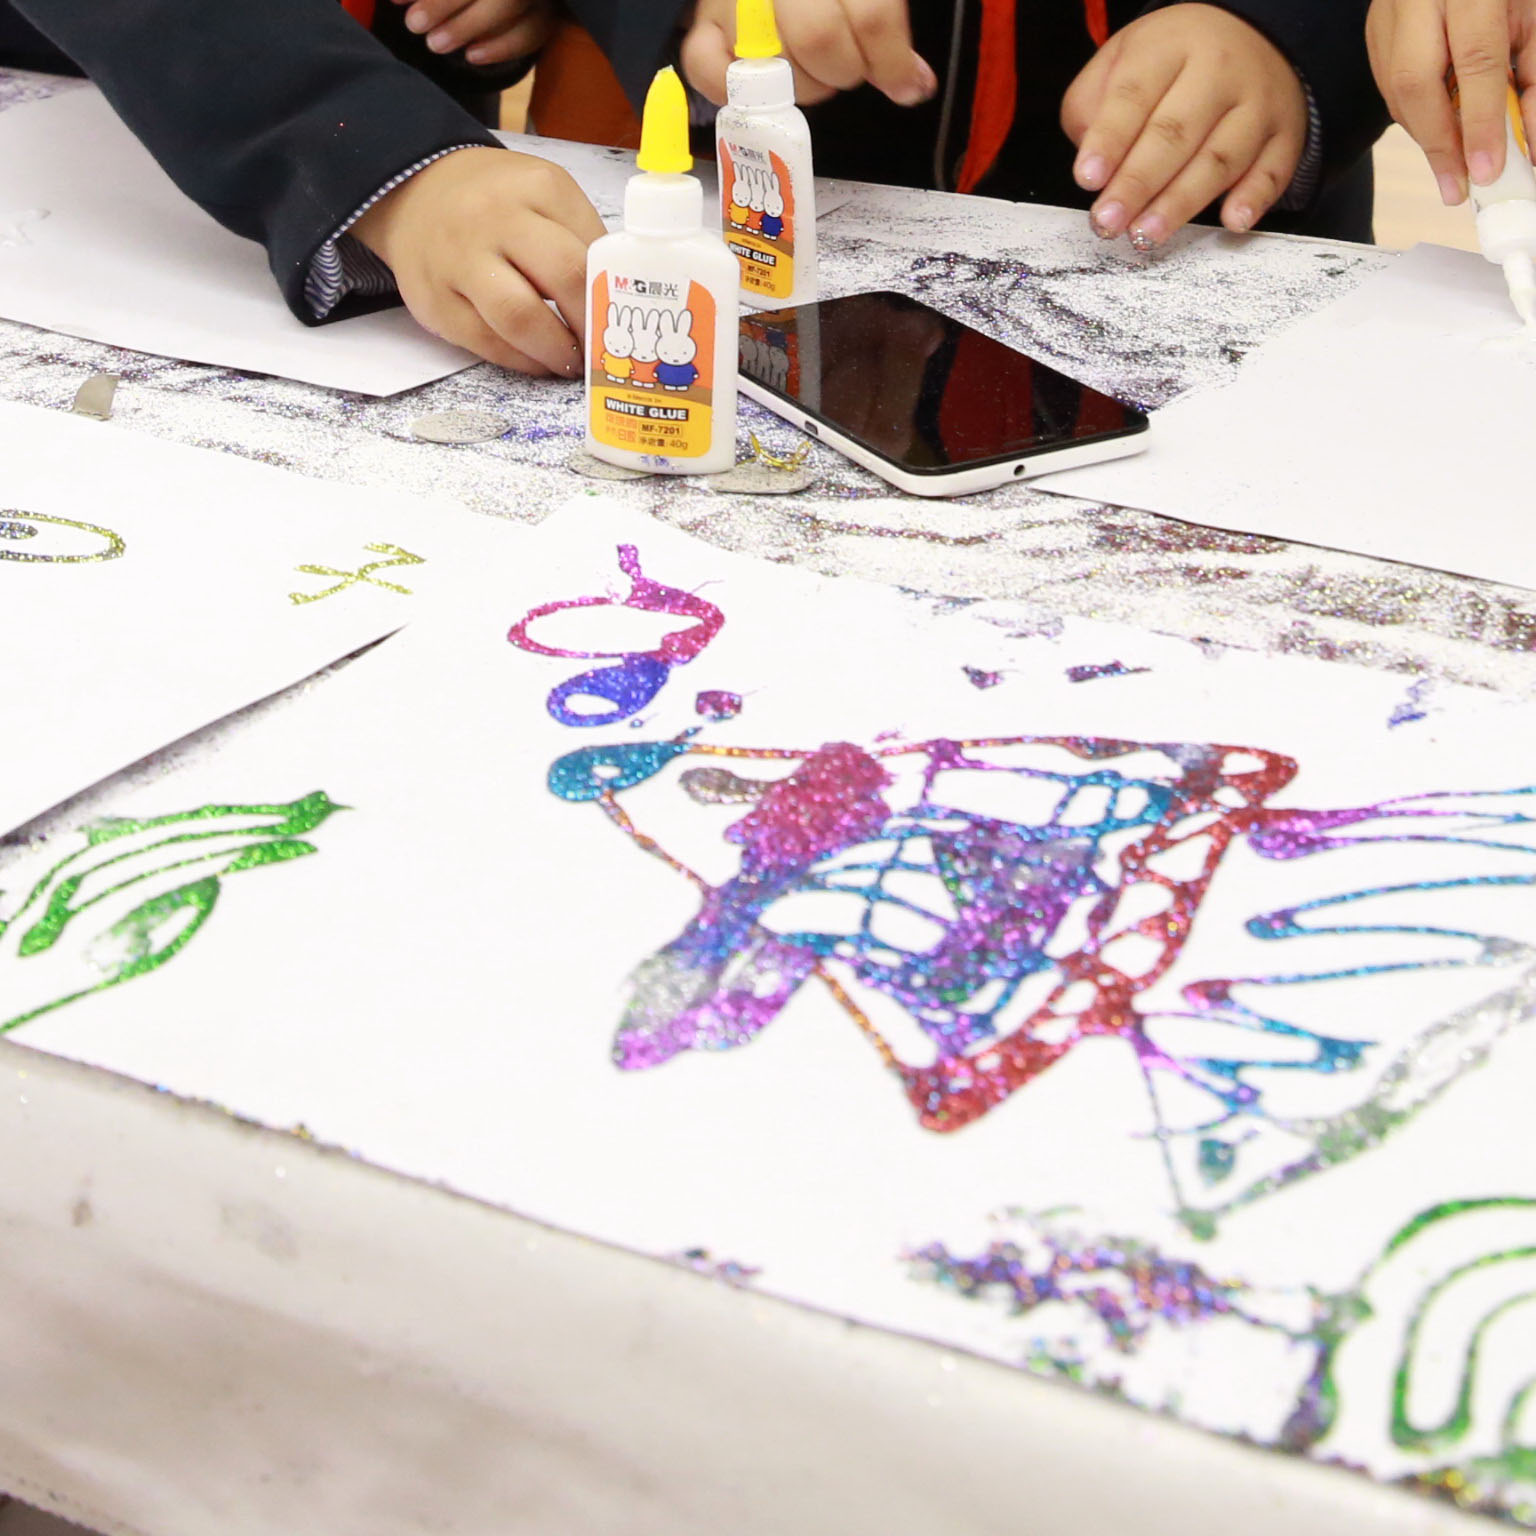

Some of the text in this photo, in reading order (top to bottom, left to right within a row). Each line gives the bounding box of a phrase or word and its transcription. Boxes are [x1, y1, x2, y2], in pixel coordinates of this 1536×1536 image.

[752, 251, 775, 265] GLUE
[606, 397, 645, 416] WHITE
[648, 407, 687, 420] GLUE
[641, 424, 681, 435] MF-7201
[670, 439, 689, 450] 40g
